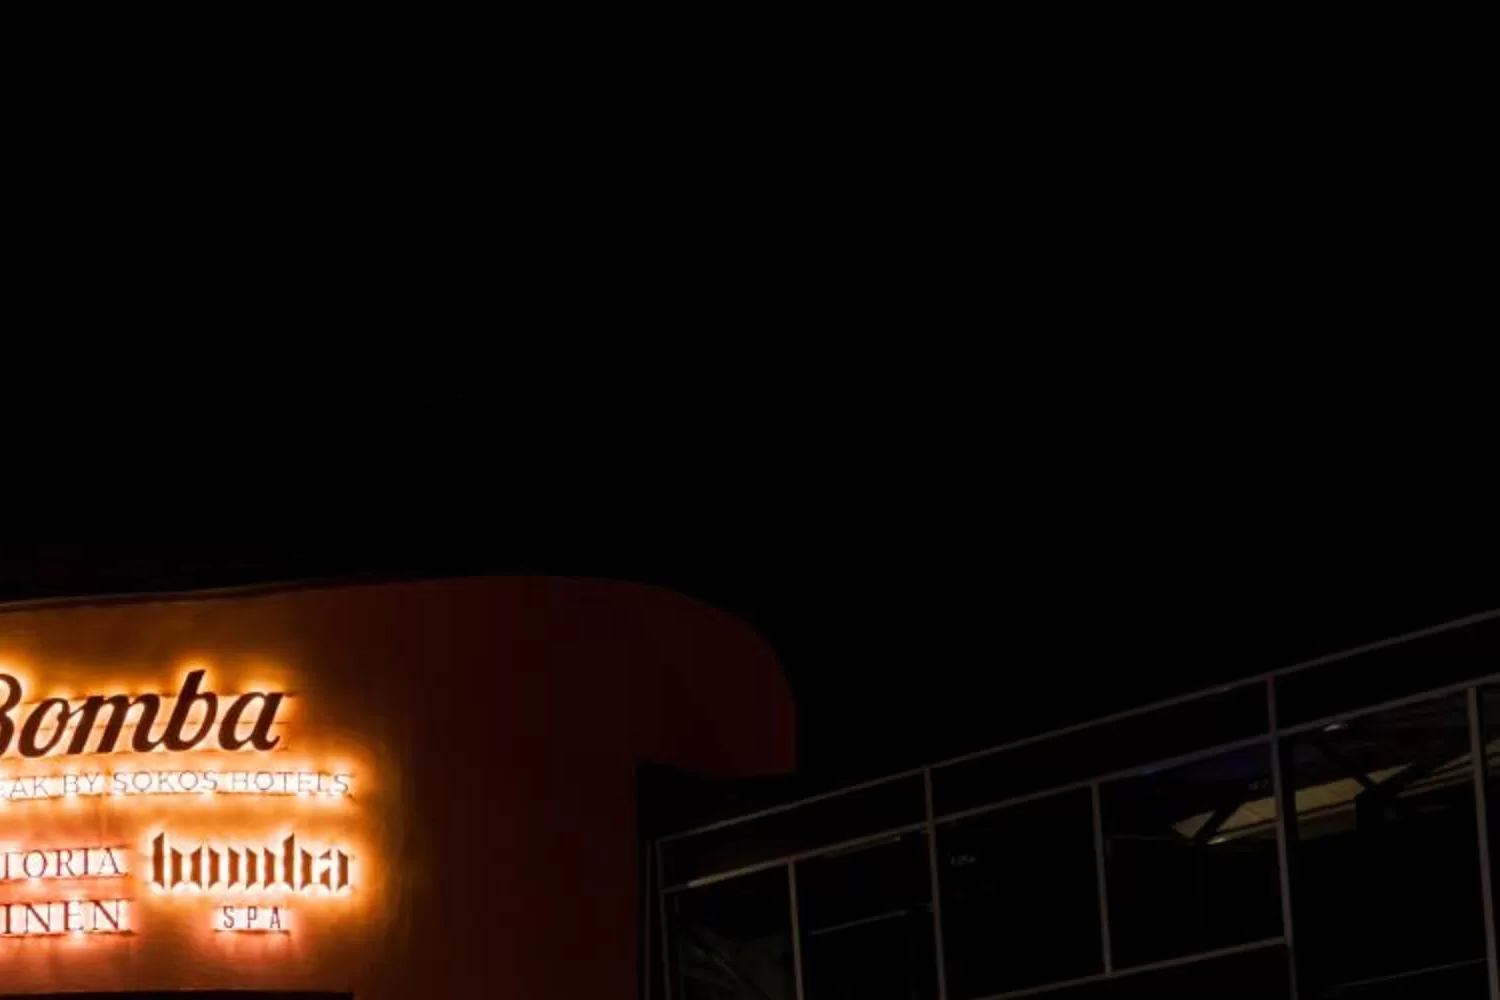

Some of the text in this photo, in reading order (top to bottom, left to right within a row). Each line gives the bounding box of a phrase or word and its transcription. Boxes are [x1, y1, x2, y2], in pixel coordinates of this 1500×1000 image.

[63, 772, 101, 796] BY
[112, 768, 219, 796] SOKOS
[230, 771, 352, 798] HOTELS
[222, 905, 282, 930] SPA
